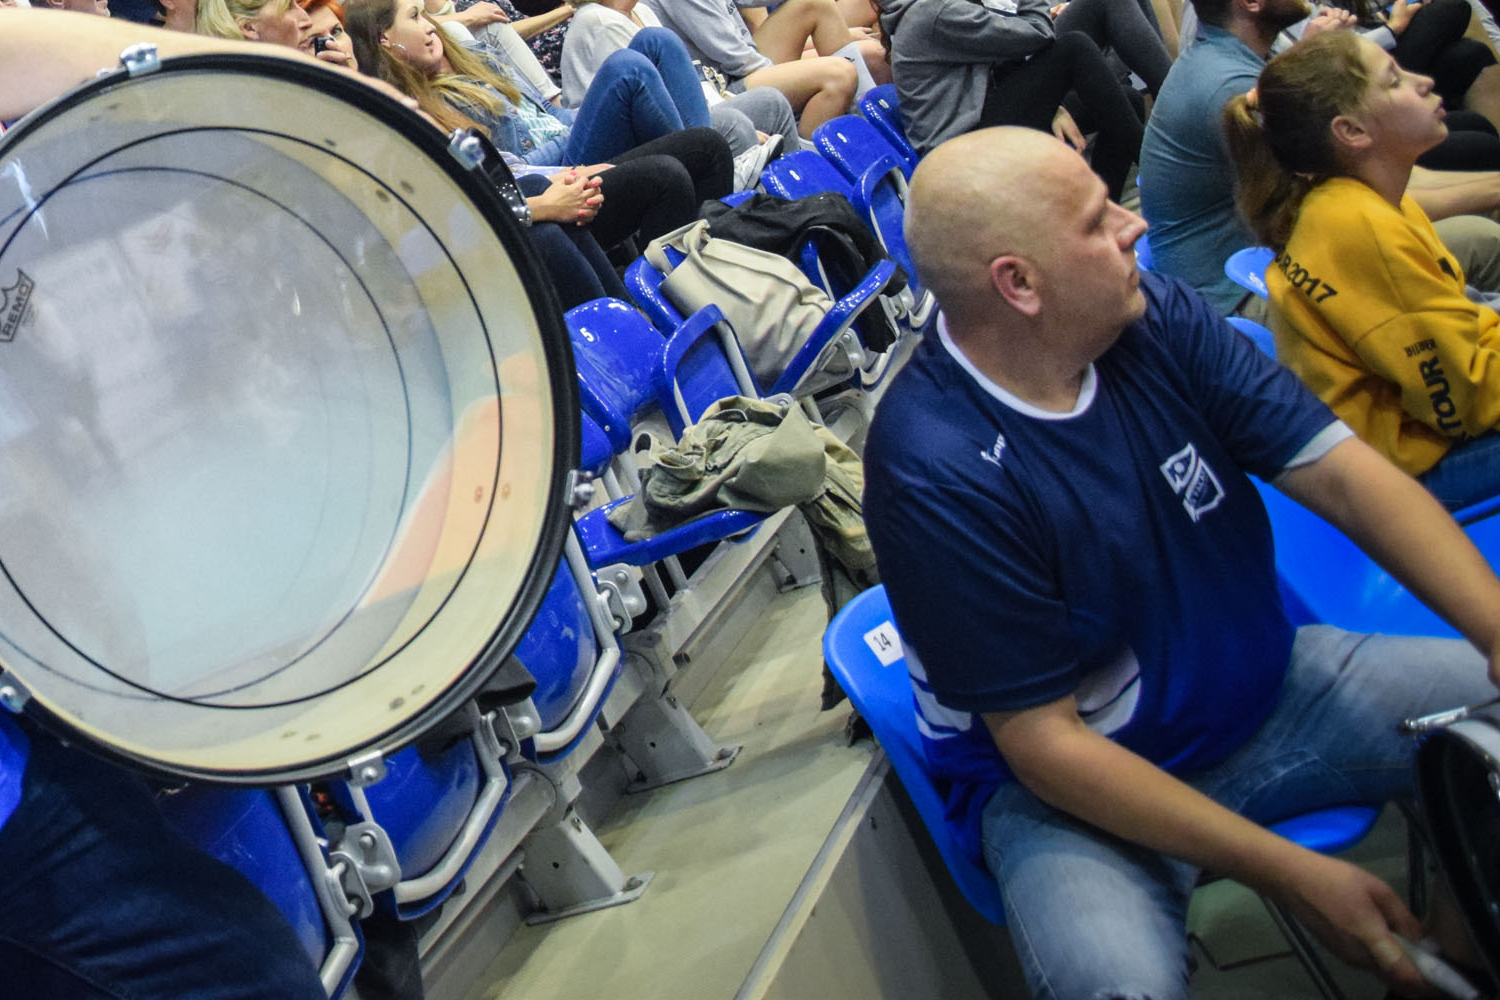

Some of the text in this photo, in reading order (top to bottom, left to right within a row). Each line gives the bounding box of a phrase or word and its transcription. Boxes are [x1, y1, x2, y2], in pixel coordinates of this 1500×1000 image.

[2, 283, 29, 336] REMO
[580, 327, 595, 343] 5
[1418, 355, 1463, 432] TOUR
[873, 632, 893, 652] 14
